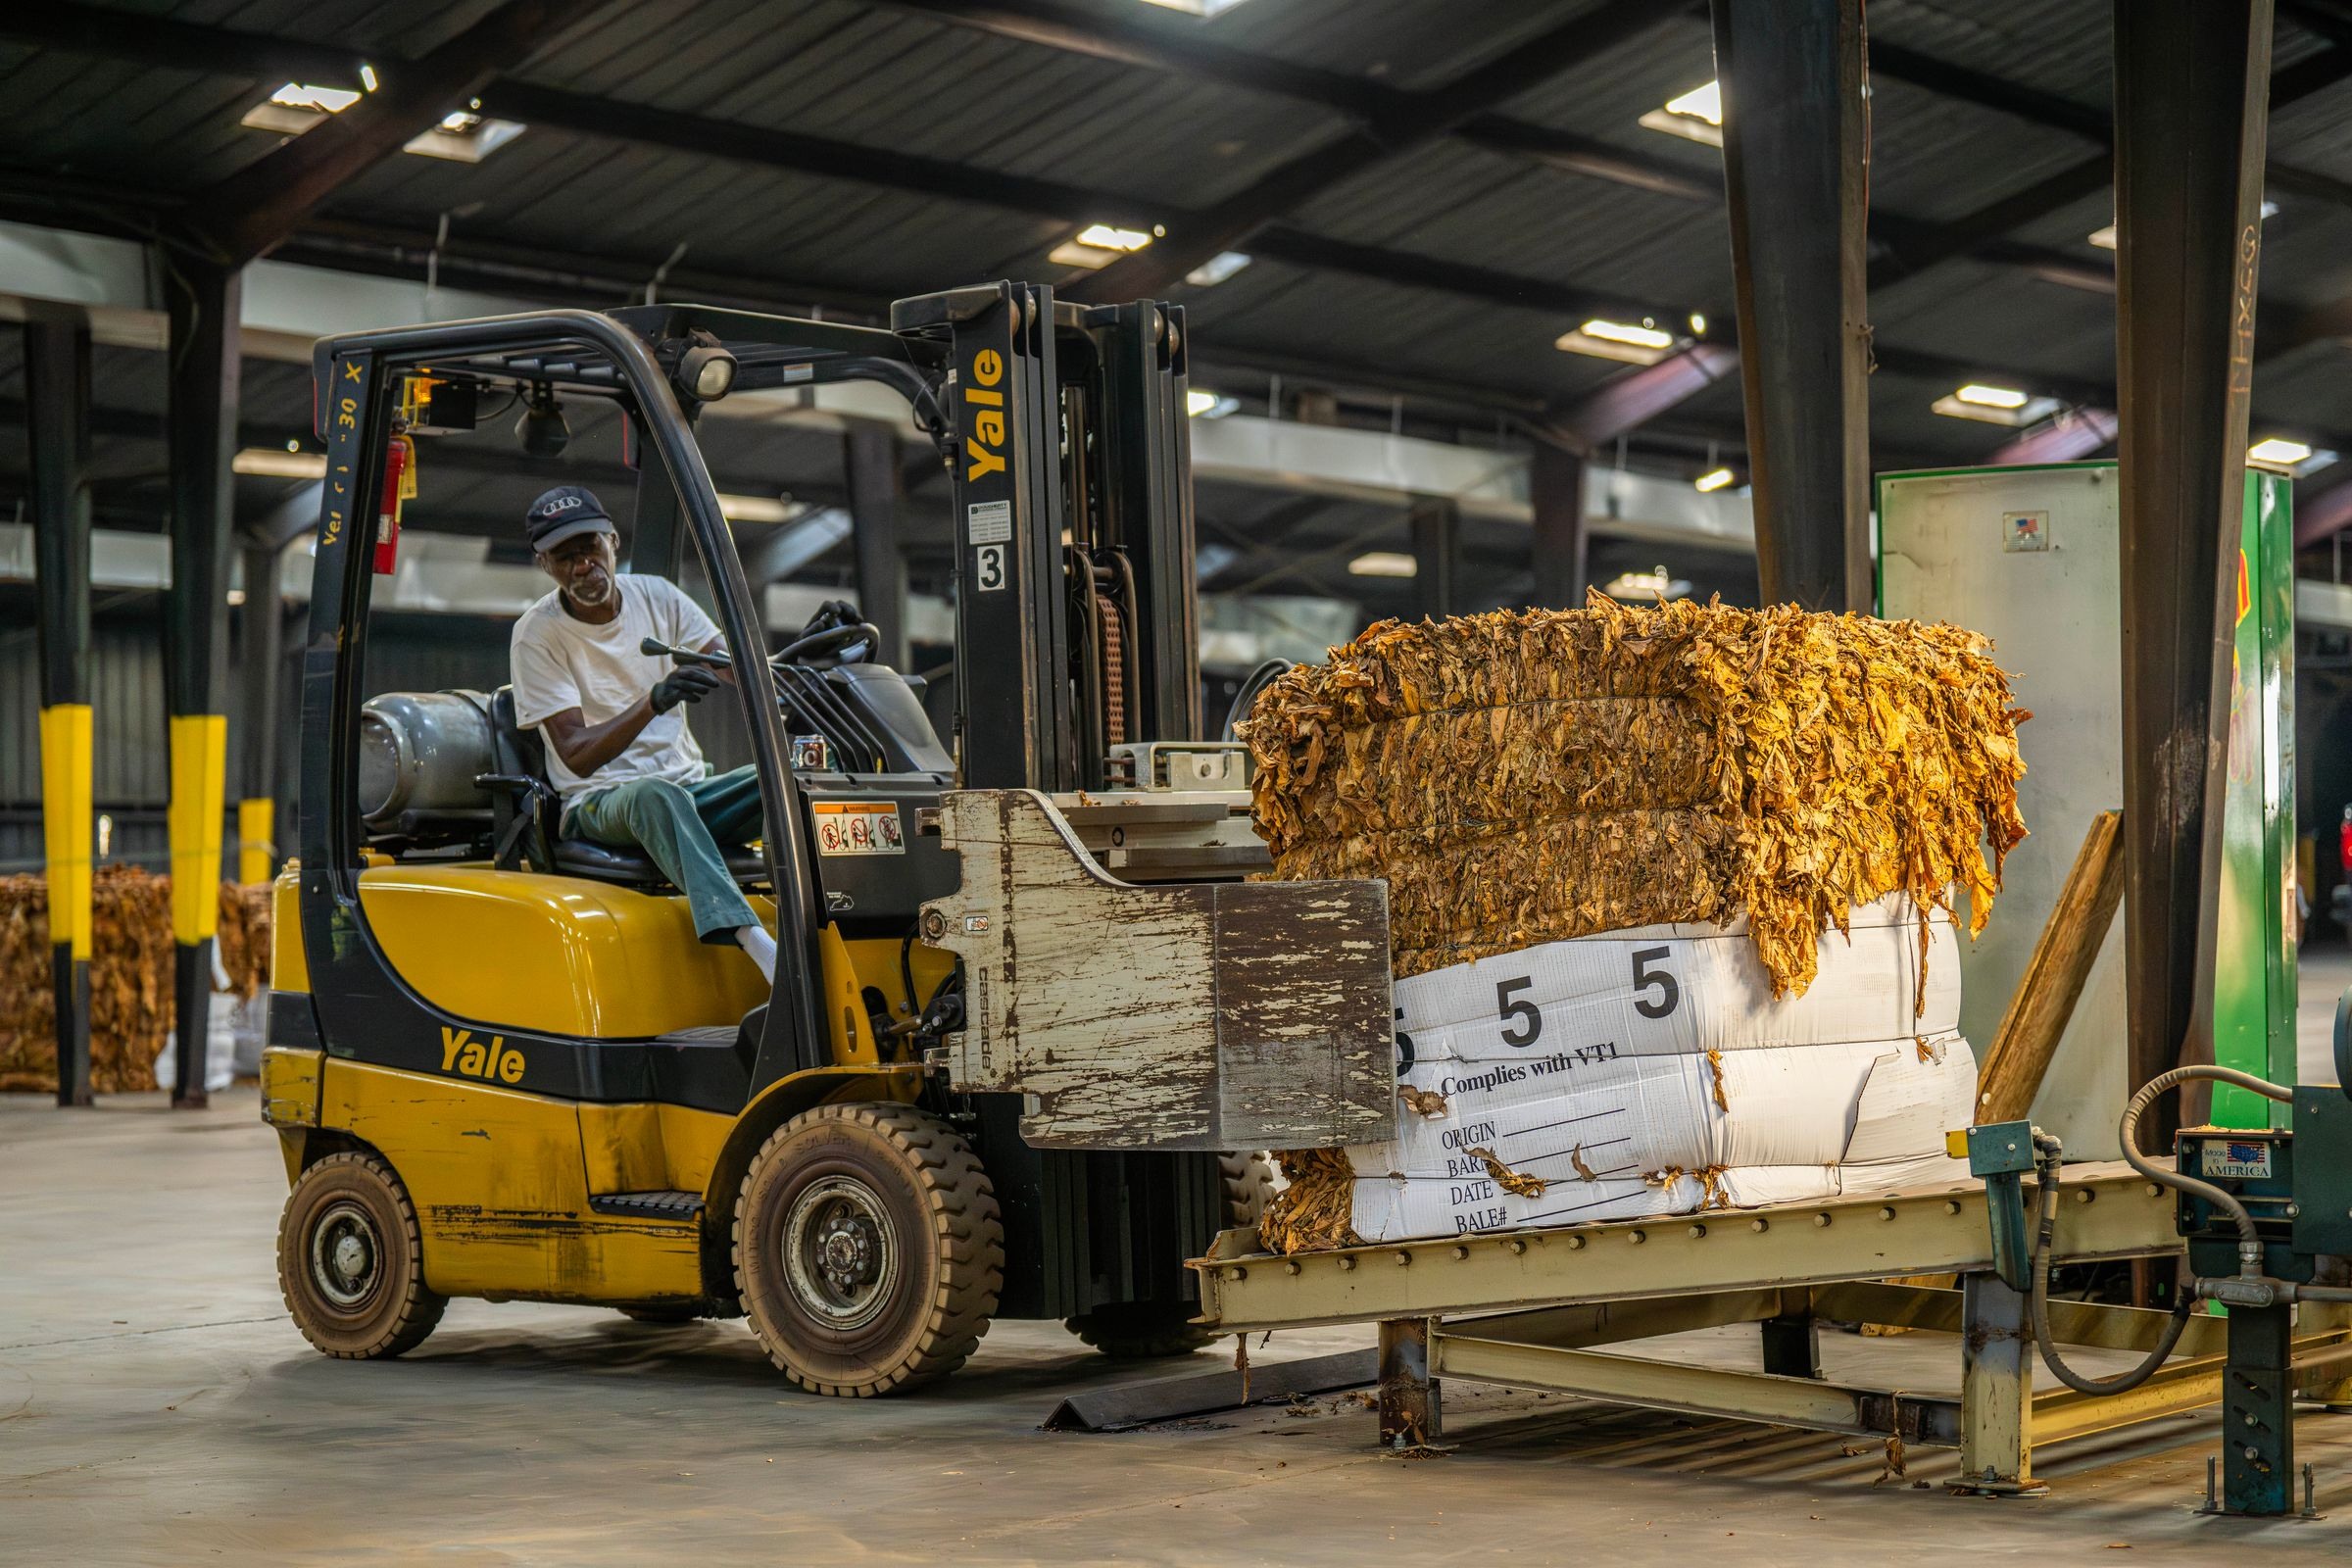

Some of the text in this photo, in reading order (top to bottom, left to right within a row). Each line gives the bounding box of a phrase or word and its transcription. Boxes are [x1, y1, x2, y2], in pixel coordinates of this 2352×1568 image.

[965, 348, 1005, 482] Yale
[980, 549, 1002, 588] 3
[979, 966, 991, 1069] cascade
[1496, 975, 1543, 1048] 5
[1632, 946, 1680, 1019] 5
[441, 1026, 526, 1084] Yale
[1441, 1041, 1620, 1097] Complies with VT1
[1442, 1120, 1496, 1150] ORIGIN
[1450, 1180, 1494, 1205] DATE
[2205, 1165, 2270, 1176] AMERICA
[1454, 1206, 1507, 1233] BALE#
